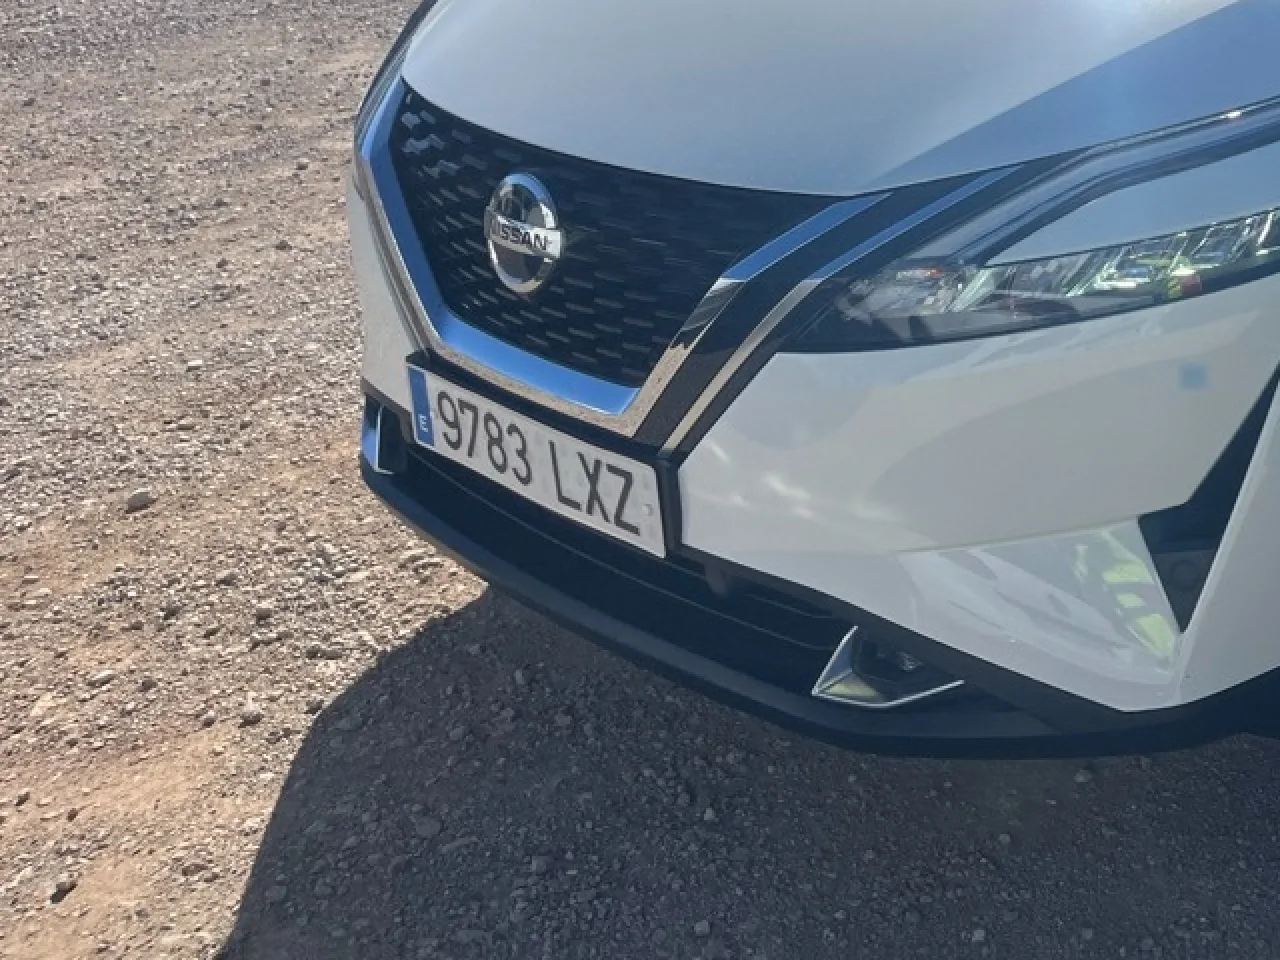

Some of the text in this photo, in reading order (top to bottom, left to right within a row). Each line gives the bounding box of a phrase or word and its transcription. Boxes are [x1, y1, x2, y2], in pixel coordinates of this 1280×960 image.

[487, 216, 548, 252] NISSAN
[437, 391, 533, 486] 9783
[548, 439, 641, 537] LXZ
